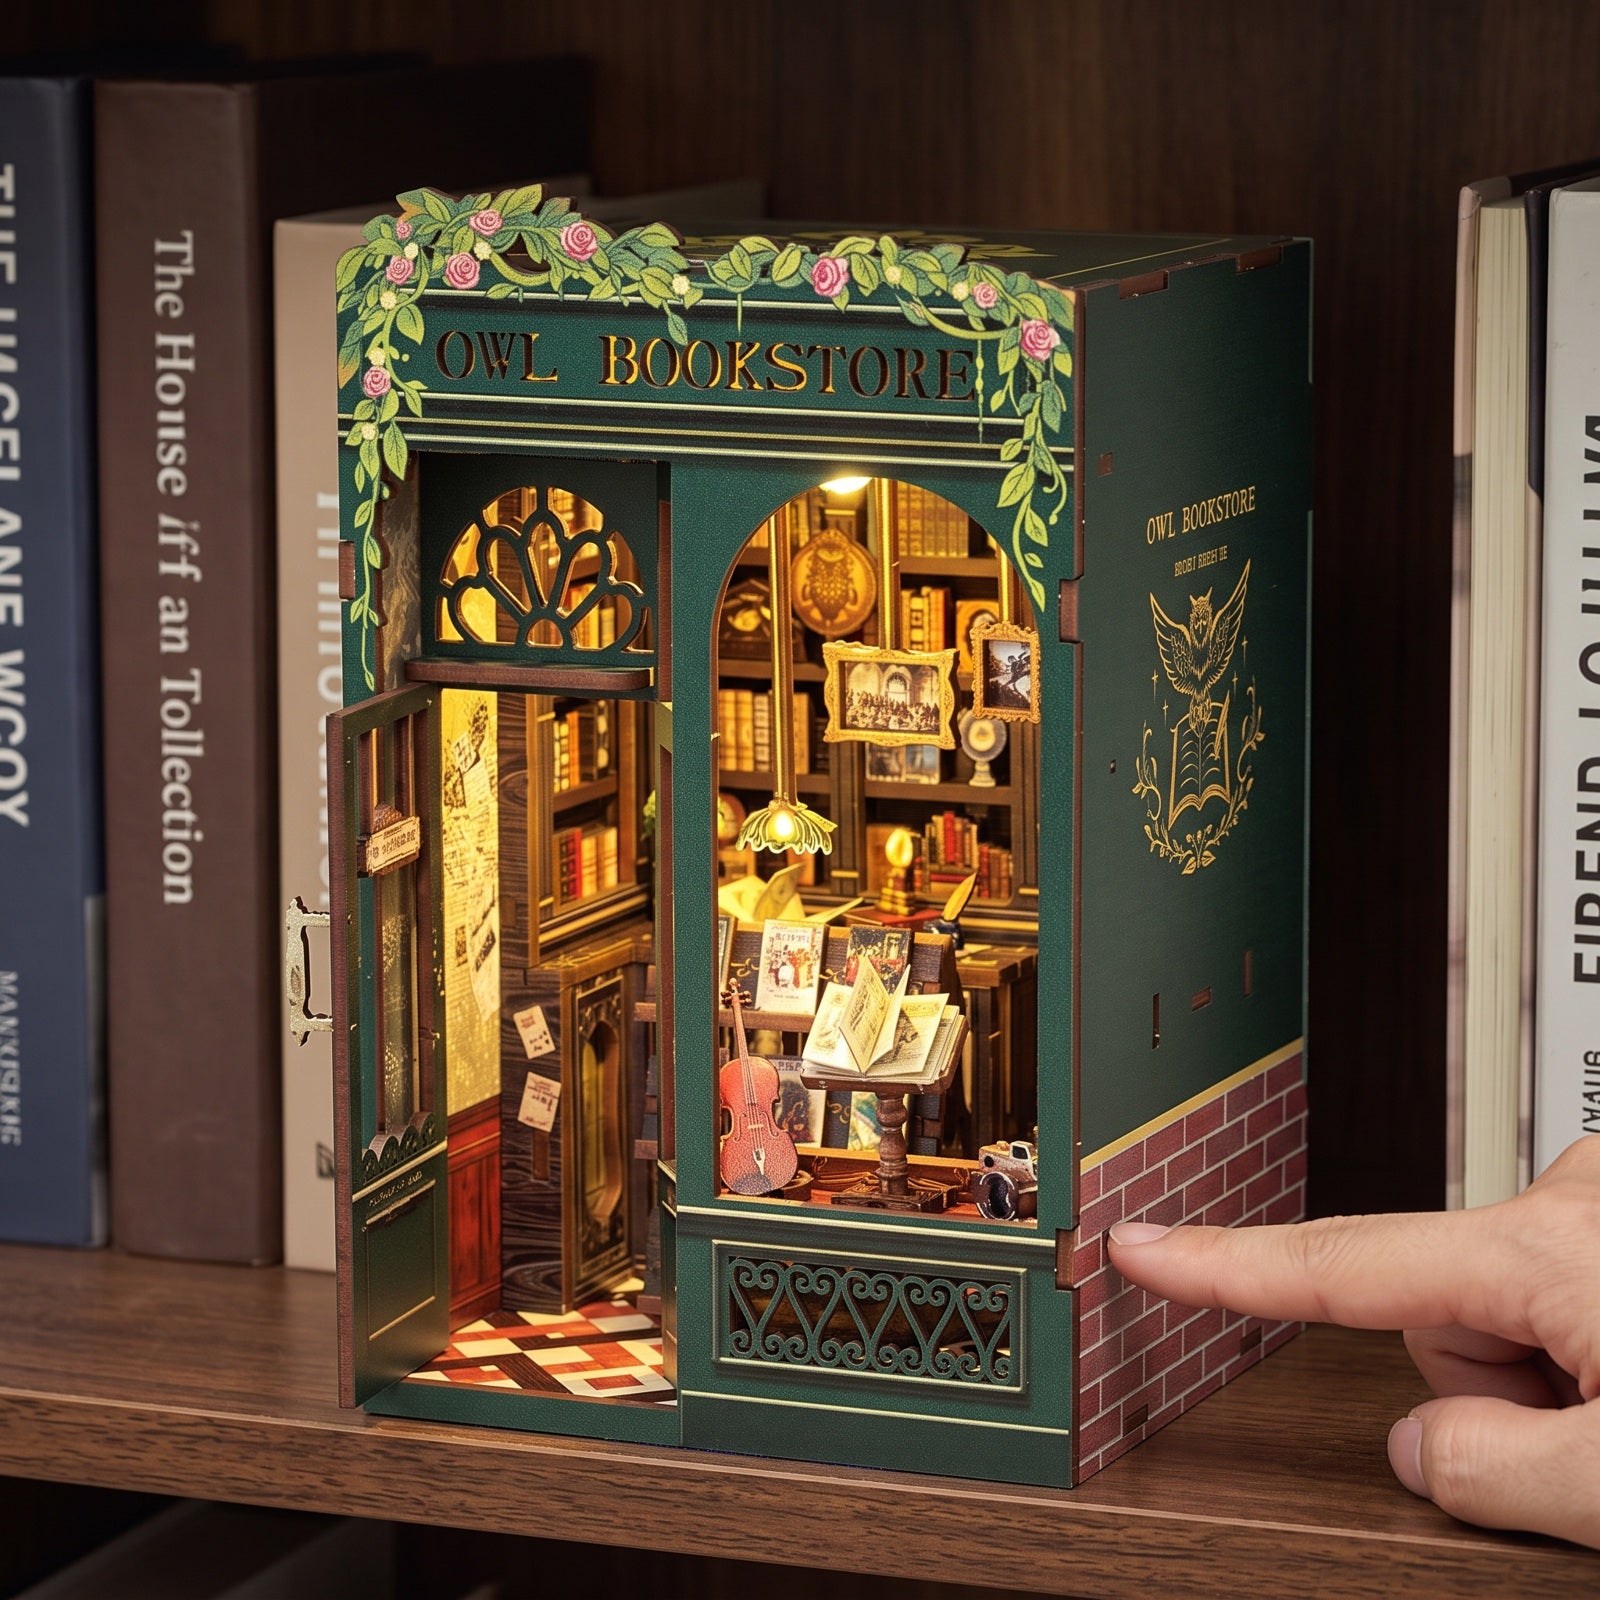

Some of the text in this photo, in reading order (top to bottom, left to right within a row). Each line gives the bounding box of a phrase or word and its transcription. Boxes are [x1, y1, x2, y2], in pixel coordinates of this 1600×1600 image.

[154, 229, 195, 318] The
[435, 330, 975, 401] OWL BOOKSTORE
[1146, 485, 1256, 545] OWL BOOKSTORE
[159, 595, 189, 654] an
[160, 668, 204, 904] Tollection
